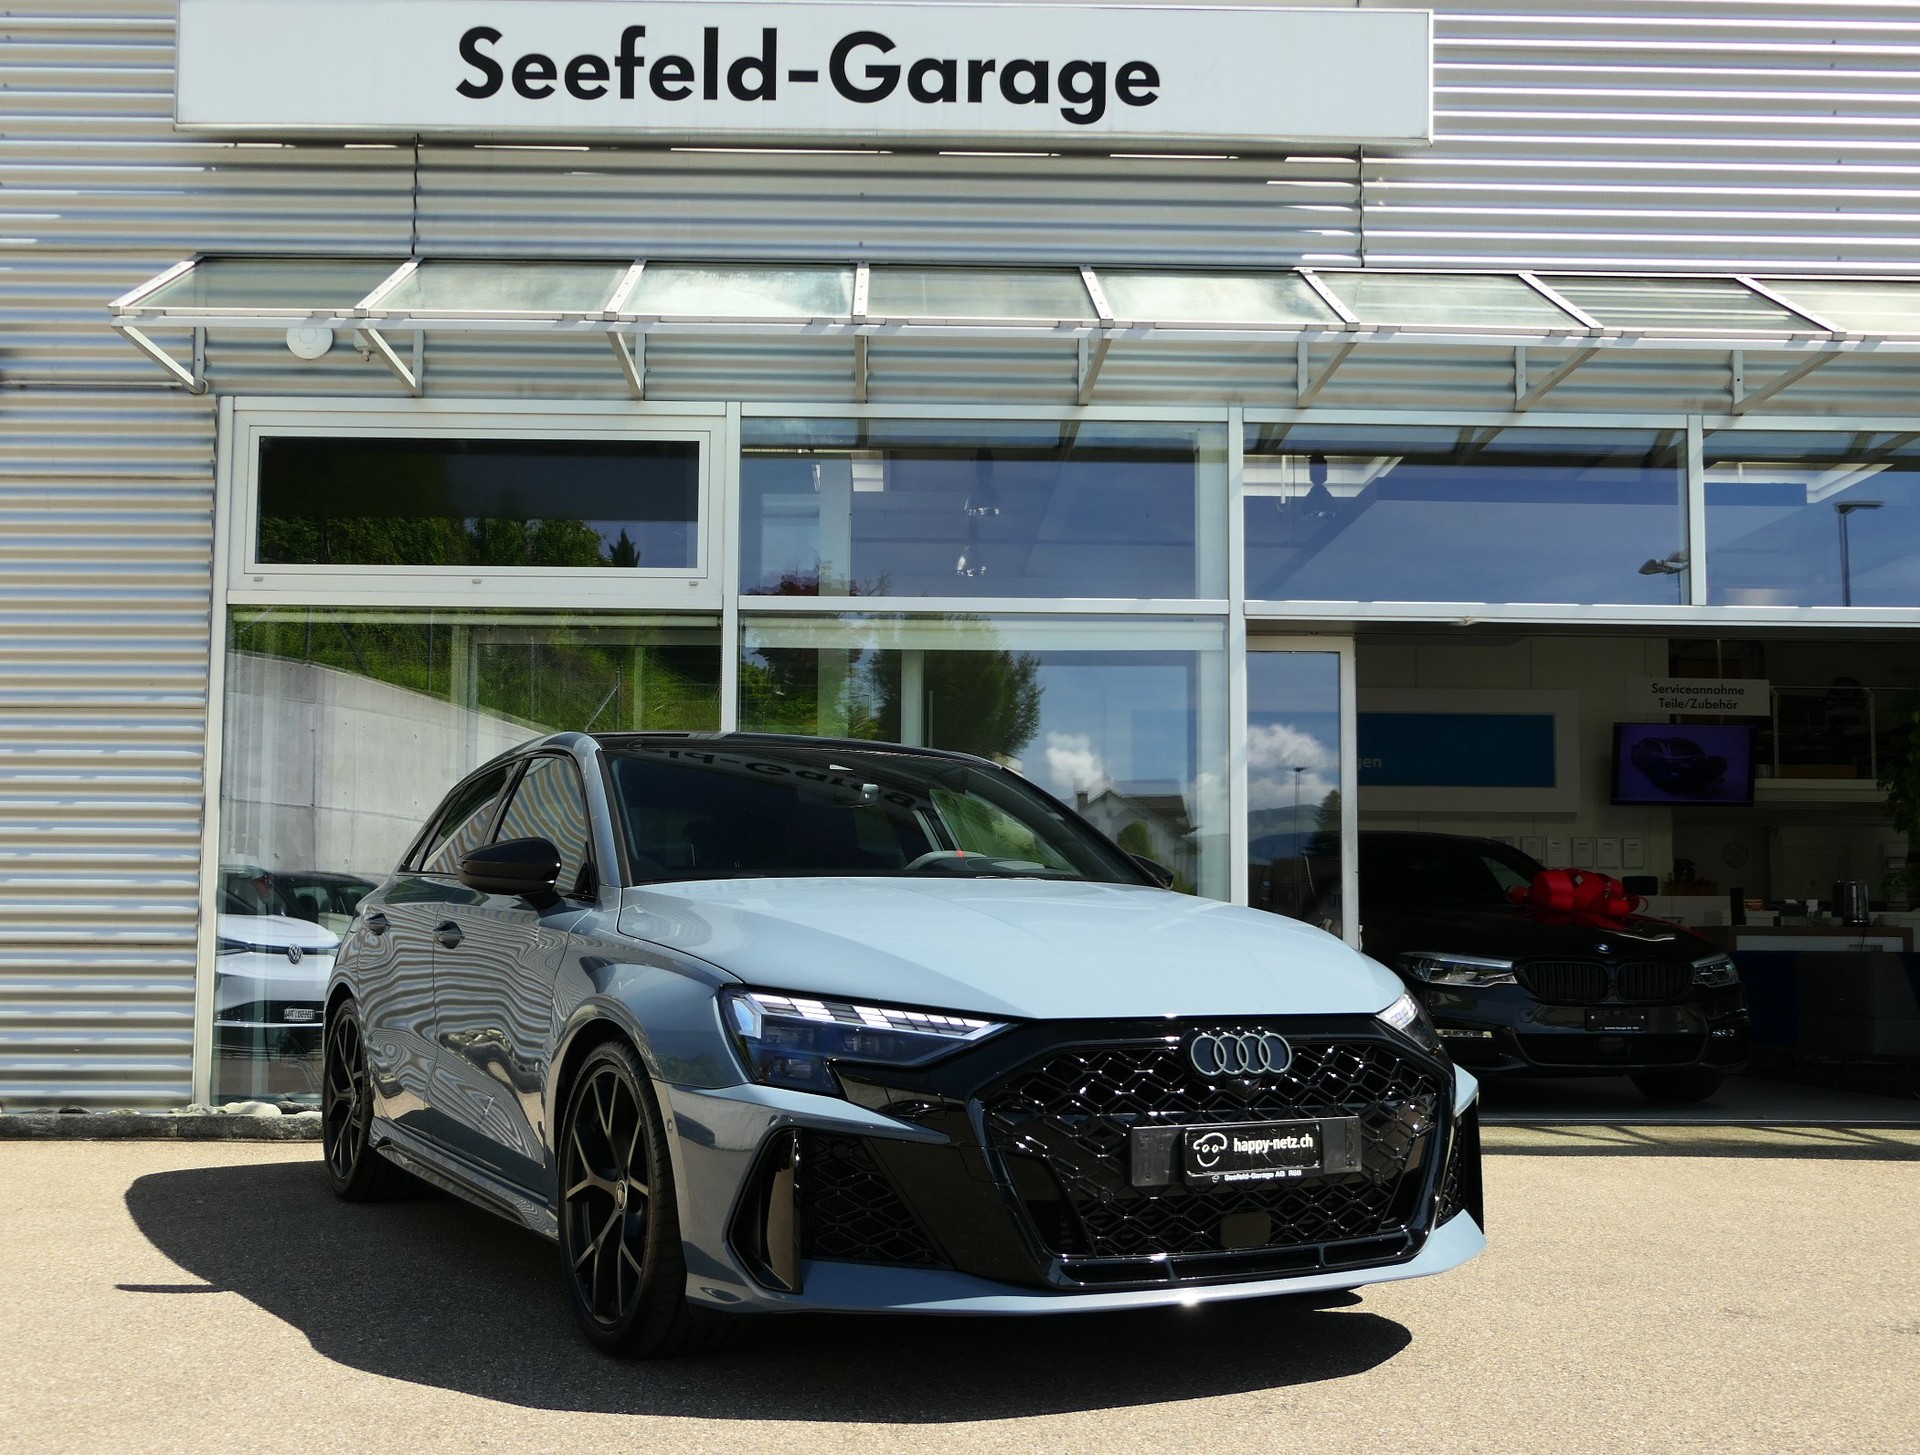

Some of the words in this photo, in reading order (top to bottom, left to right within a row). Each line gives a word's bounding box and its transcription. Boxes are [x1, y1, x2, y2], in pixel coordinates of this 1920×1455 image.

[456, 25, 1161, 125] Seefeld-Garage
[1651, 682, 1745, 696] Serviceannahme
[1658, 697, 1738, 710] Teile/Zubehör
[1233, 1133, 1314, 1155] happy-netz.ch
